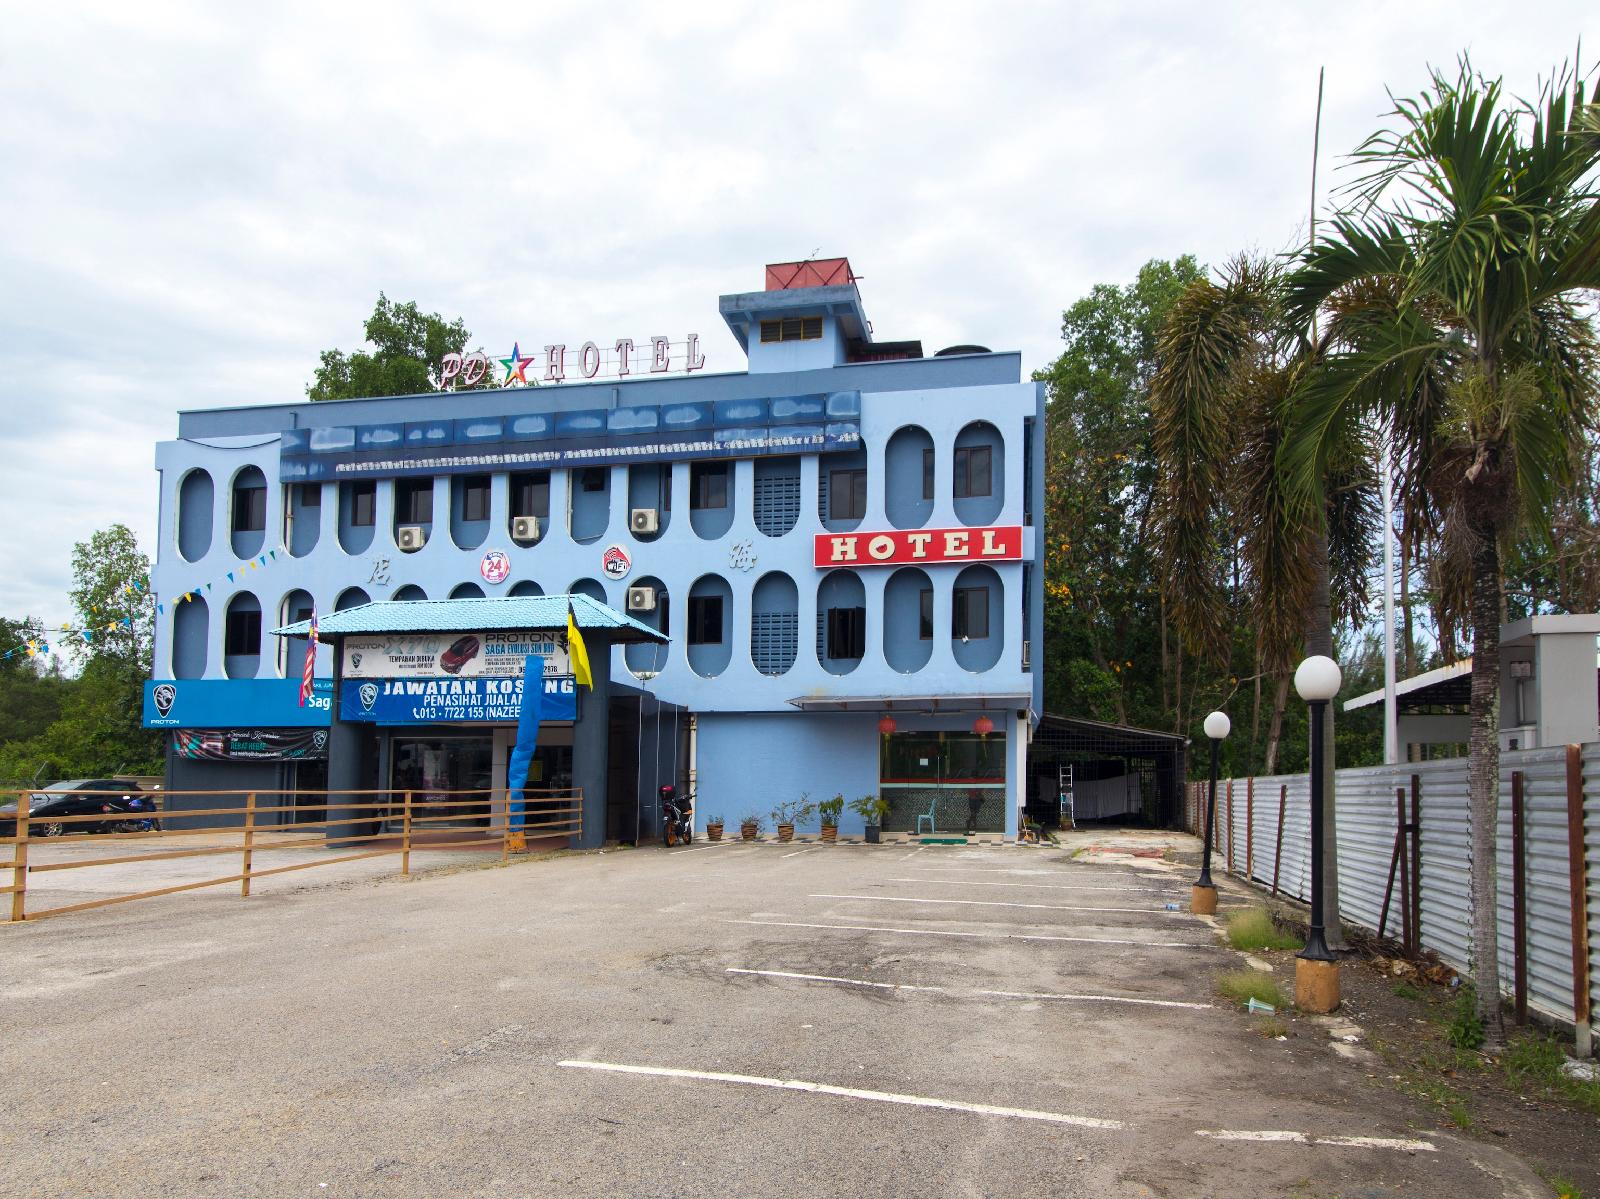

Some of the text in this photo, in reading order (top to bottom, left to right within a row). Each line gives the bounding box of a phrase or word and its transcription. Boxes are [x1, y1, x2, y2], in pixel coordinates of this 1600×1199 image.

[544, 333, 706, 381] HOTEL
[830, 530, 1006, 560] HOTEL
[487, 559, 502, 572] 24
[486, 633, 554, 643] PROTON
[486, 644, 506, 654] SAGA
[508, 643, 530, 654] EVOLUSI
[384, 680, 574, 695] JAWATAN KOSNG
[308, 695, 332, 710] Sag
[424, 694, 482, 706] PENASIHAT
[420, 708, 436, 718] 013
[445, 707, 464, 718] 7722
[468, 706, 484, 718] 155
[486, 706, 521, 720] (NAZEE
